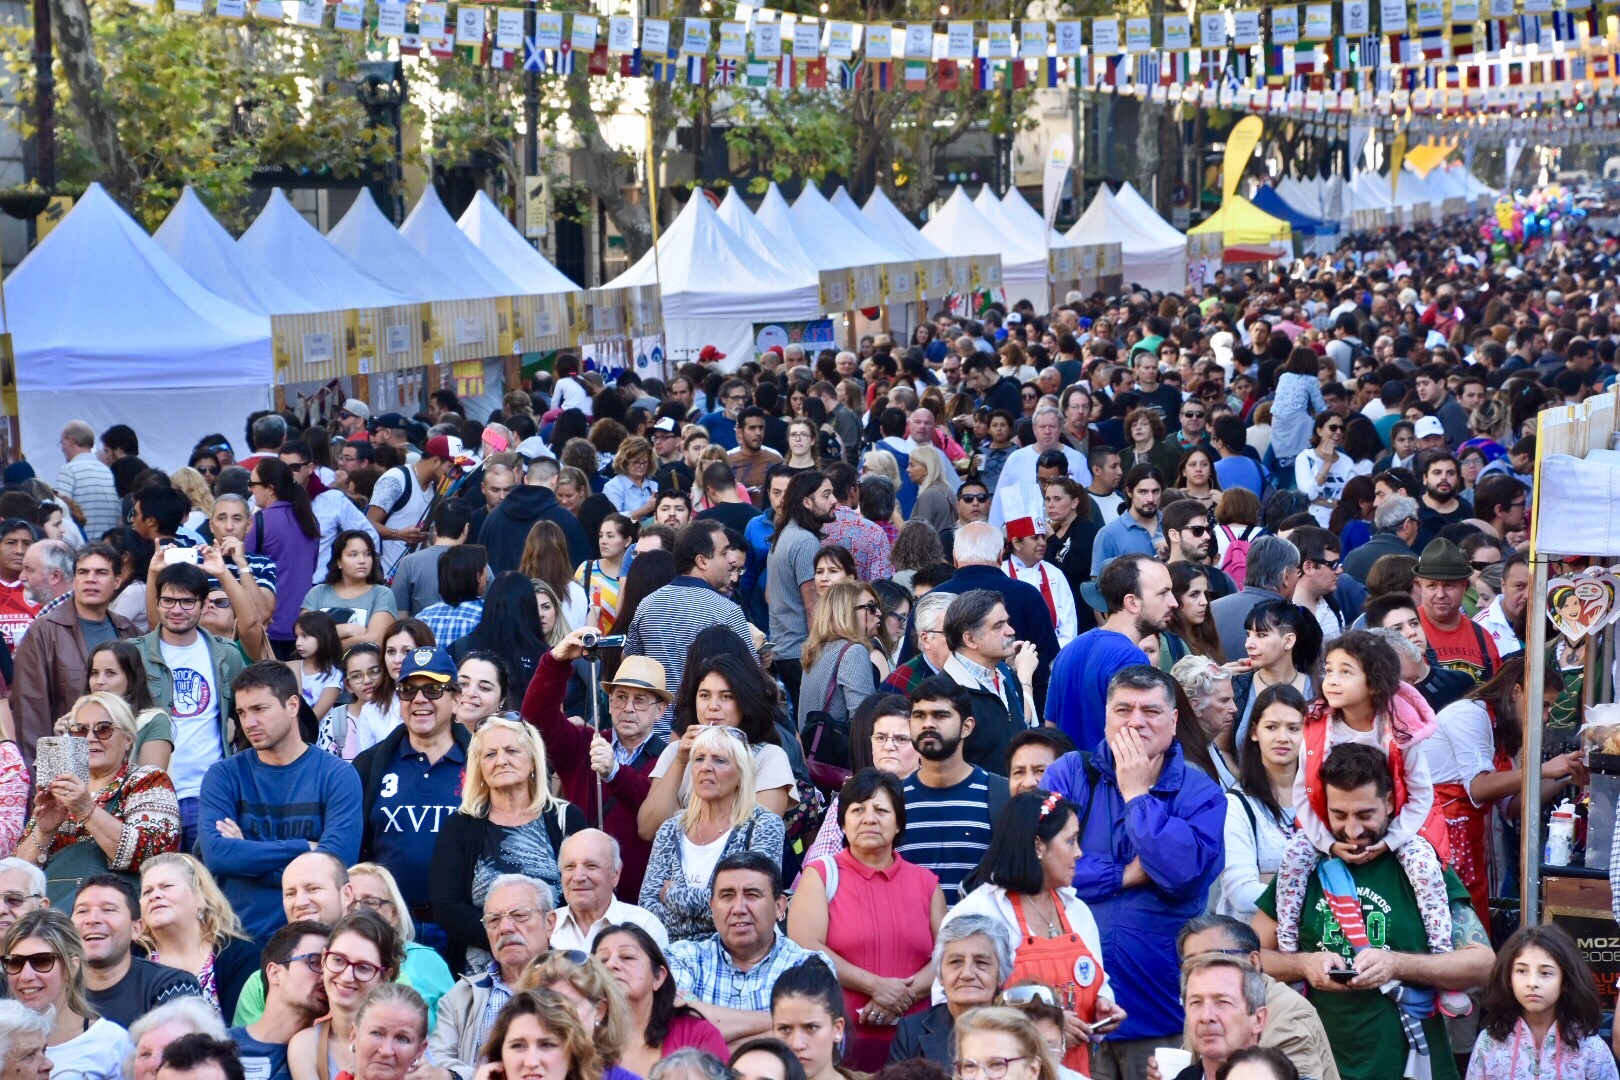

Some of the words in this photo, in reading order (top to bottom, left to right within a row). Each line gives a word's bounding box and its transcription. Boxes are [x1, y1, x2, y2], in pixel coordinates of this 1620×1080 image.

[172, 670, 194, 680] ROCK
[176, 681, 191, 692] OUT
[380, 773, 399, 798] 3
